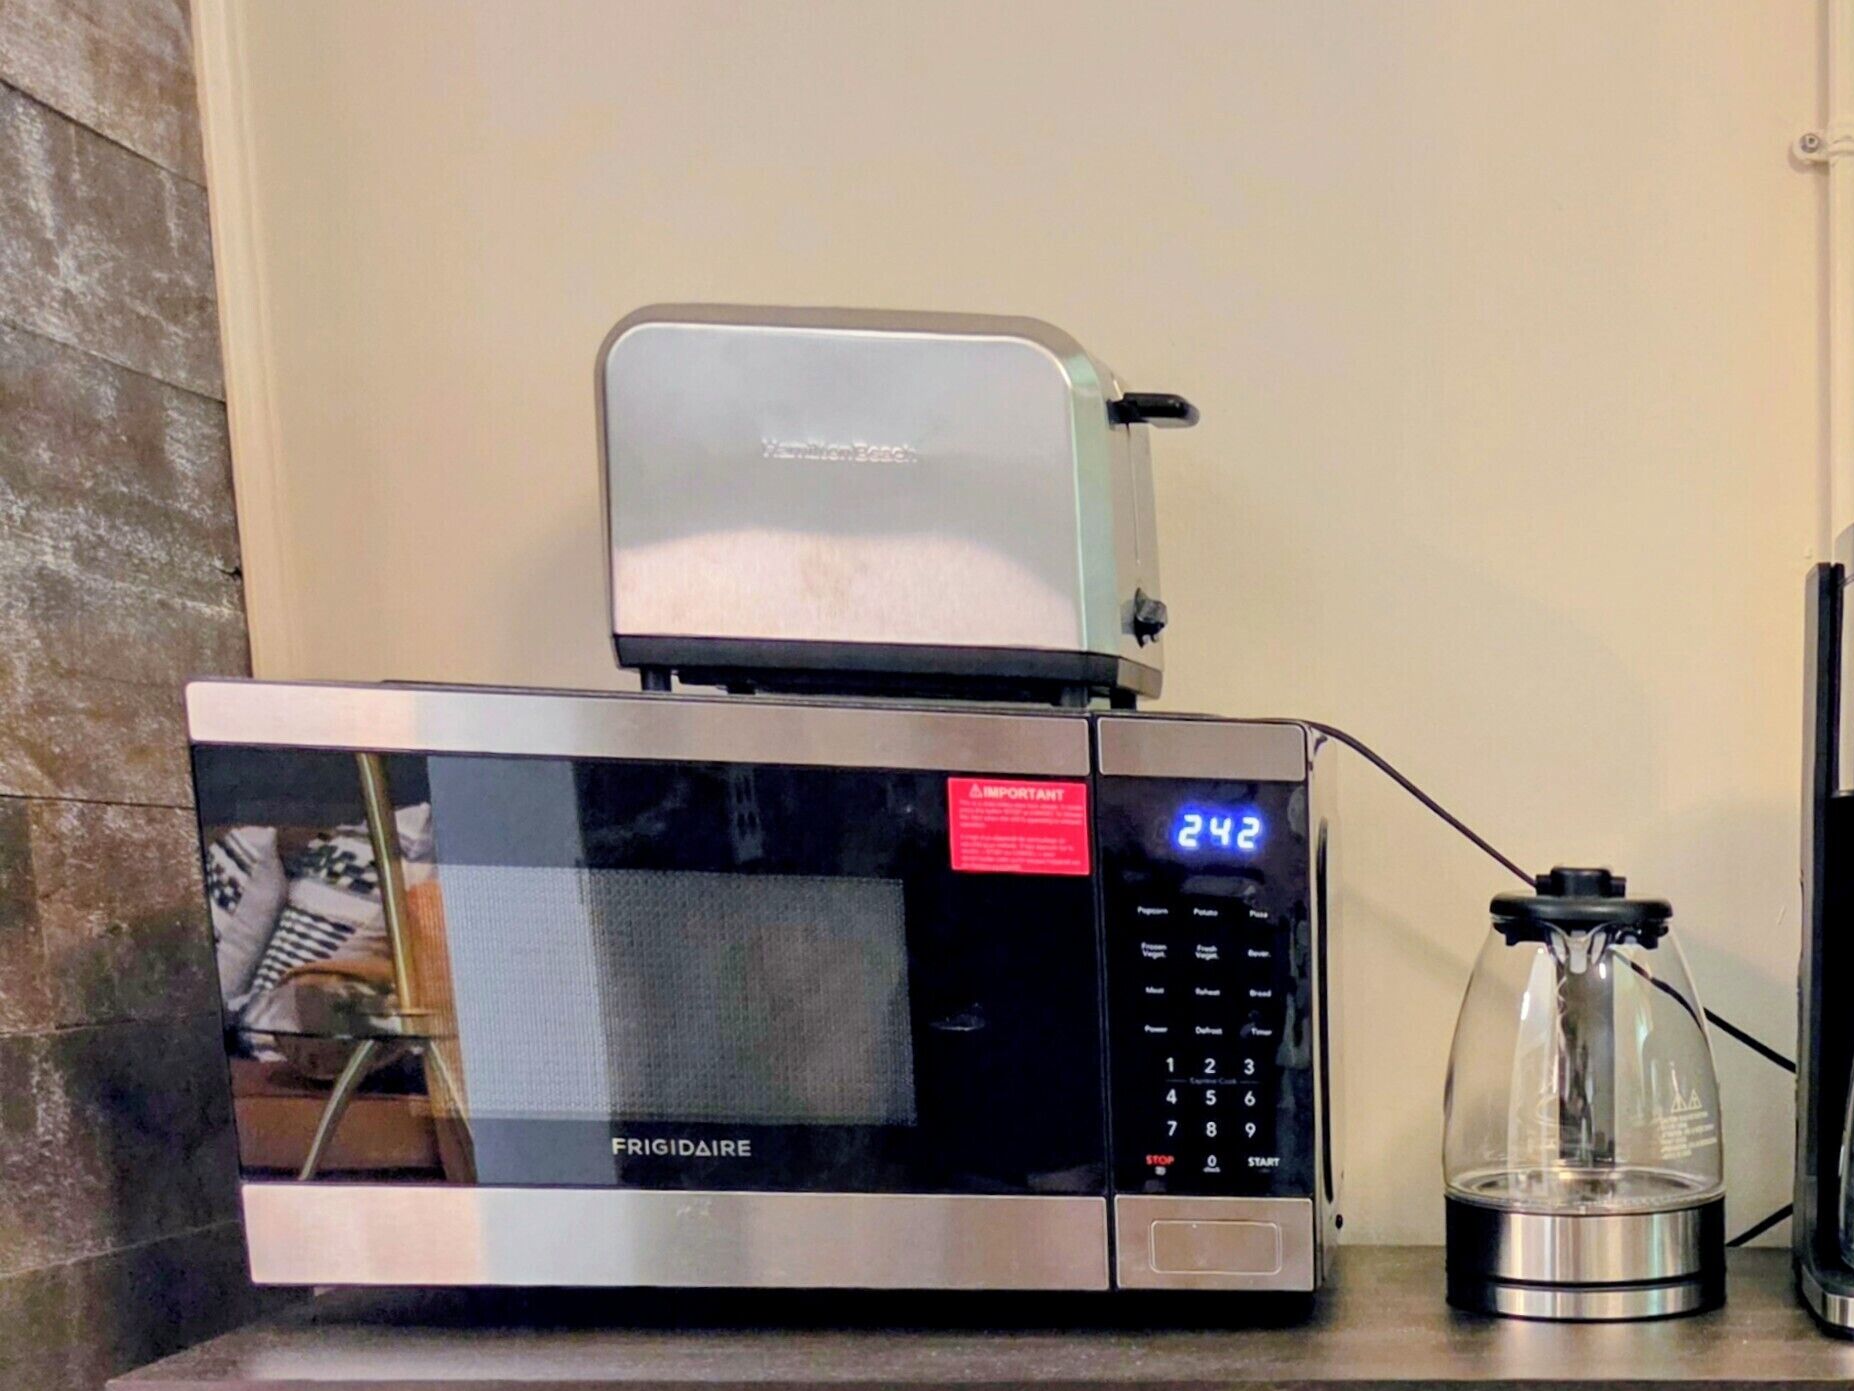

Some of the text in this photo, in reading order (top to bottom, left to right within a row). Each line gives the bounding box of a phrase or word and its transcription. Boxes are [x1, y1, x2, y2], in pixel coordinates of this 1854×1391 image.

[983, 786, 1065, 801] IMPORTANT
[1144, 1025, 1168, 1033] Power
[1166, 1057, 1174, 1073] 1
[1204, 1058, 1216, 1074] 2
[1244, 1058, 1255, 1075] 3
[1166, 1088, 1177, 1104] 4
[1205, 1089, 1217, 1105] 5
[1244, 1090, 1256, 1106] 6
[1167, 1120, 1178, 1136] 7
[1206, 1121, 1217, 1137] 8
[1245, 1122, 1256, 1138] 9
[611, 1138, 752, 1157] FRIGIDAIRE
[1146, 1154, 1174, 1165] STOP
[1207, 1154, 1217, 1167] 0
[1247, 1156, 1280, 1167] START
